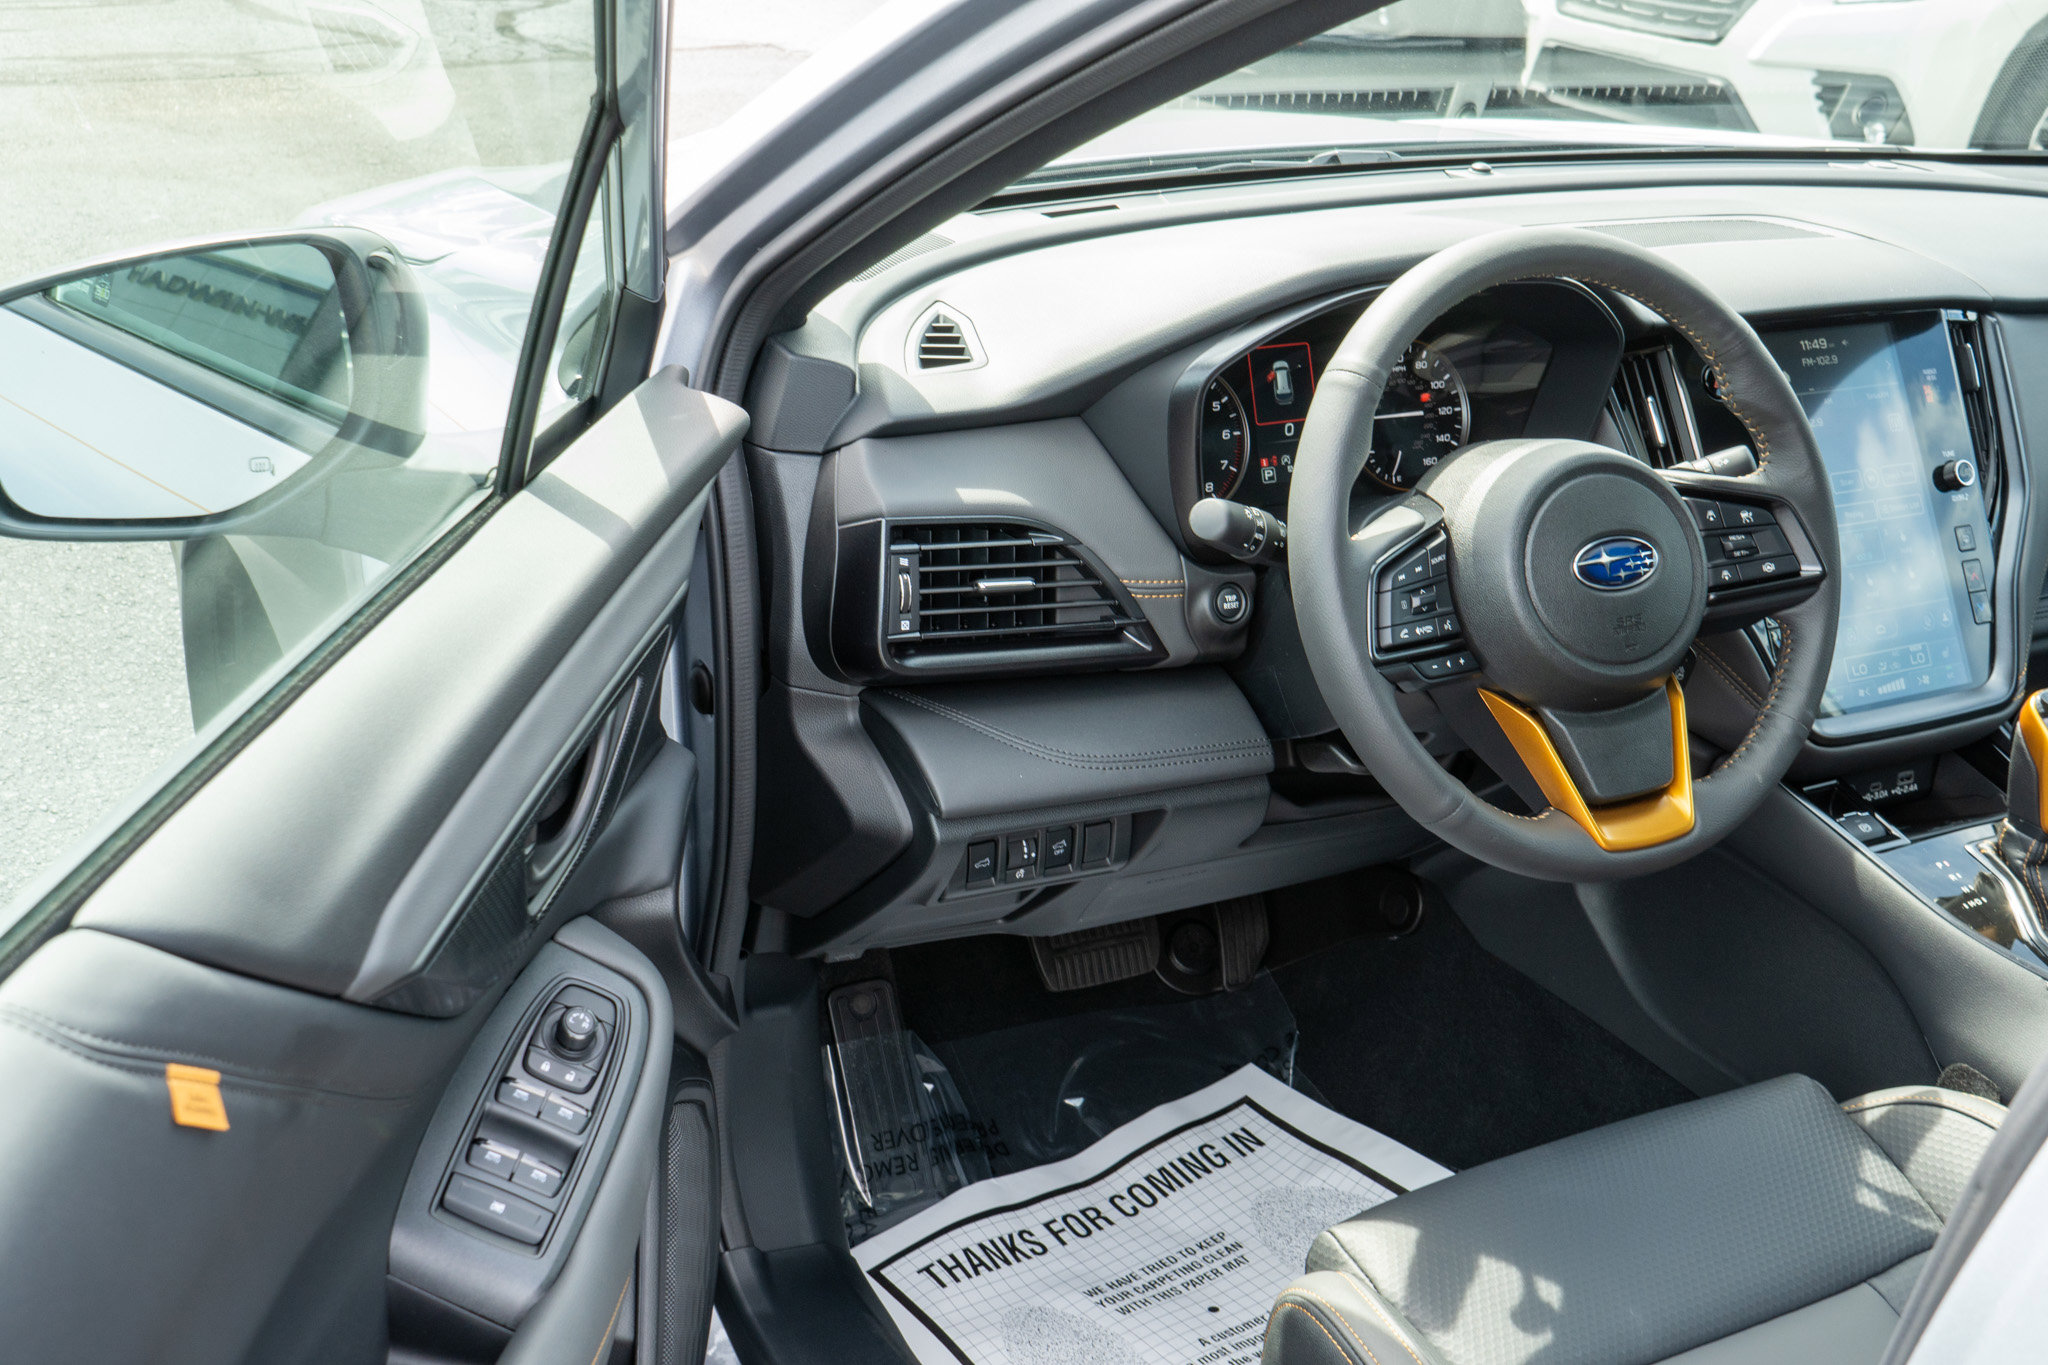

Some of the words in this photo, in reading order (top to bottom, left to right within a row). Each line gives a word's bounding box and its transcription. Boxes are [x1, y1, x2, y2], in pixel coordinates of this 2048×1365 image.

[1800, 338, 1827, 350] 11:49
[1415, 361, 1428, 369] 80
[1802, 355, 1839, 367] FM-102.9
[1430, 381, 1445, 389] 100
[1212, 401, 1221, 412] 5
[1438, 406, 1452, 415] 120
[1222, 429, 1231, 440] 6
[1284, 422, 1295, 437] 0
[1436, 433, 1451, 443] 140
[1220, 460, 1229, 470] 7
[1423, 456, 1438, 466] 160
[1264, 470, 1273, 480] P
[1205, 482, 1214, 493] 8
[1224, 602, 1239, 610] RESET
[1910, 652, 1926, 665] LO
[1851, 664, 1868, 677] LO
[917, 1229, 1048, 1288] THANKS
[1043, 1207, 1115, 1246] FOR
[1109, 1143, 1231, 1217] COMING
[1222, 1127, 1266, 1157] IN
[1082, 1285, 1107, 1298] WE
[1106, 1271, 1141, 1290] HAVE
[1139, 1255, 1178, 1275] TRIED
[1177, 1246, 1197, 1259] TO
[1195, 1231, 1226, 1251] KEEP
[1095, 1289, 1134, 1308] YOUR
[1133, 1260, 1204, 1295] CARPETING
[1202, 1241, 1244, 1264] CLEAN
[1115, 1298, 1152, 1316] WITH
[1151, 1286, 1183, 1302] THIS
[1181, 1267, 1224, 1291] PAPER
[1222, 1254, 1251, 1272] MAT
[1198, 1337, 1212, 1347] A
[1211, 1314, 1268, 1342] customer
[1197, 1346, 1232, 1365] most
[1228, 1356, 1252, 1365] the
